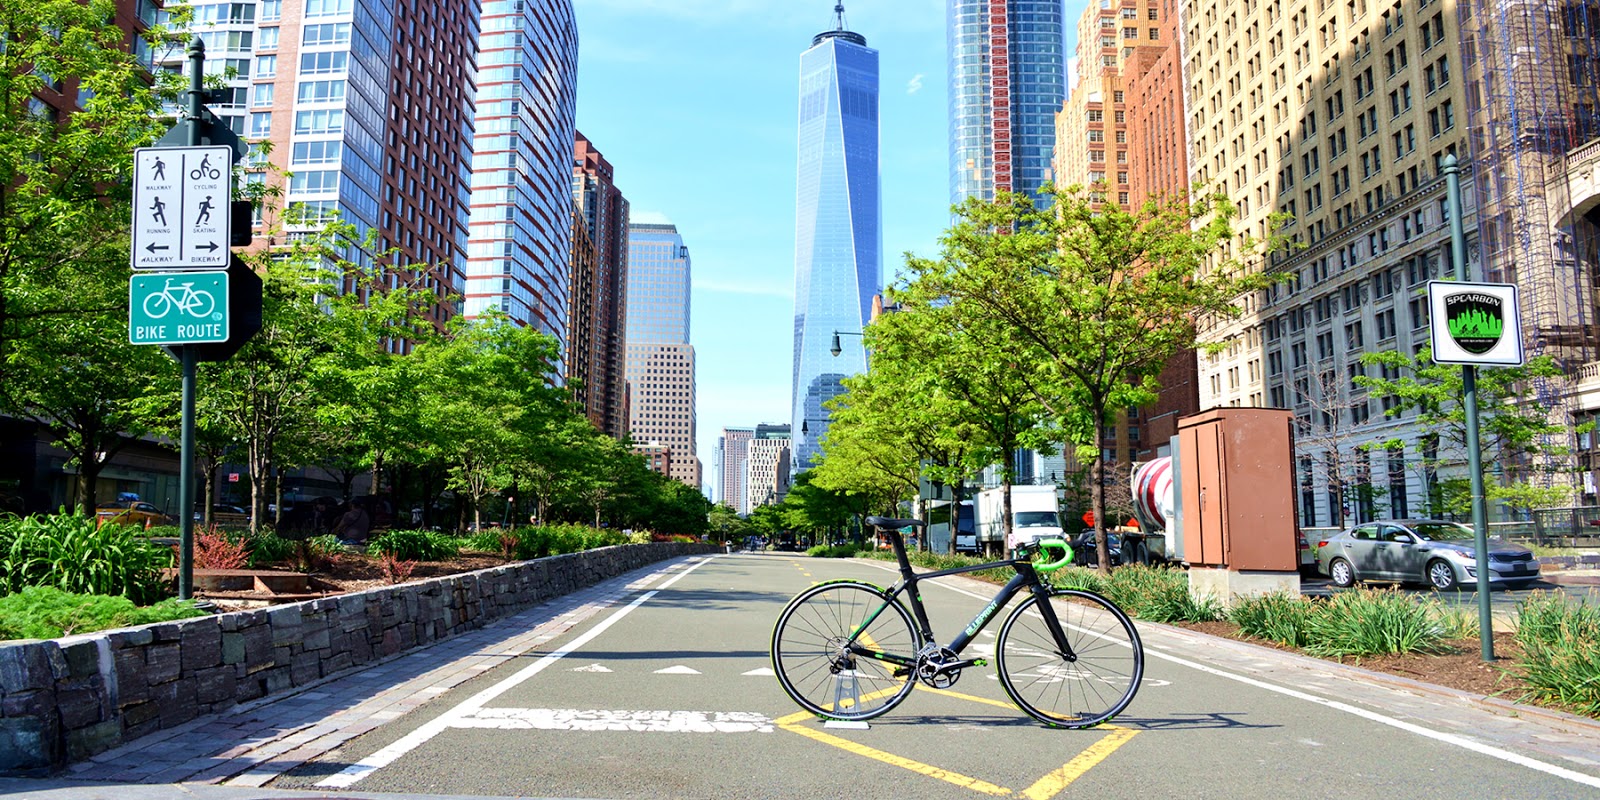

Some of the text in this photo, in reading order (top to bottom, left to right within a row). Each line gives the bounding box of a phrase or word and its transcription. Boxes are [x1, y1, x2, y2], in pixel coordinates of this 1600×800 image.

[1447, 294, 1500, 306] SPCARBON
[136, 323, 222, 339] BIKE ROUTE
[965, 600, 998, 636] BLUEPRINT
